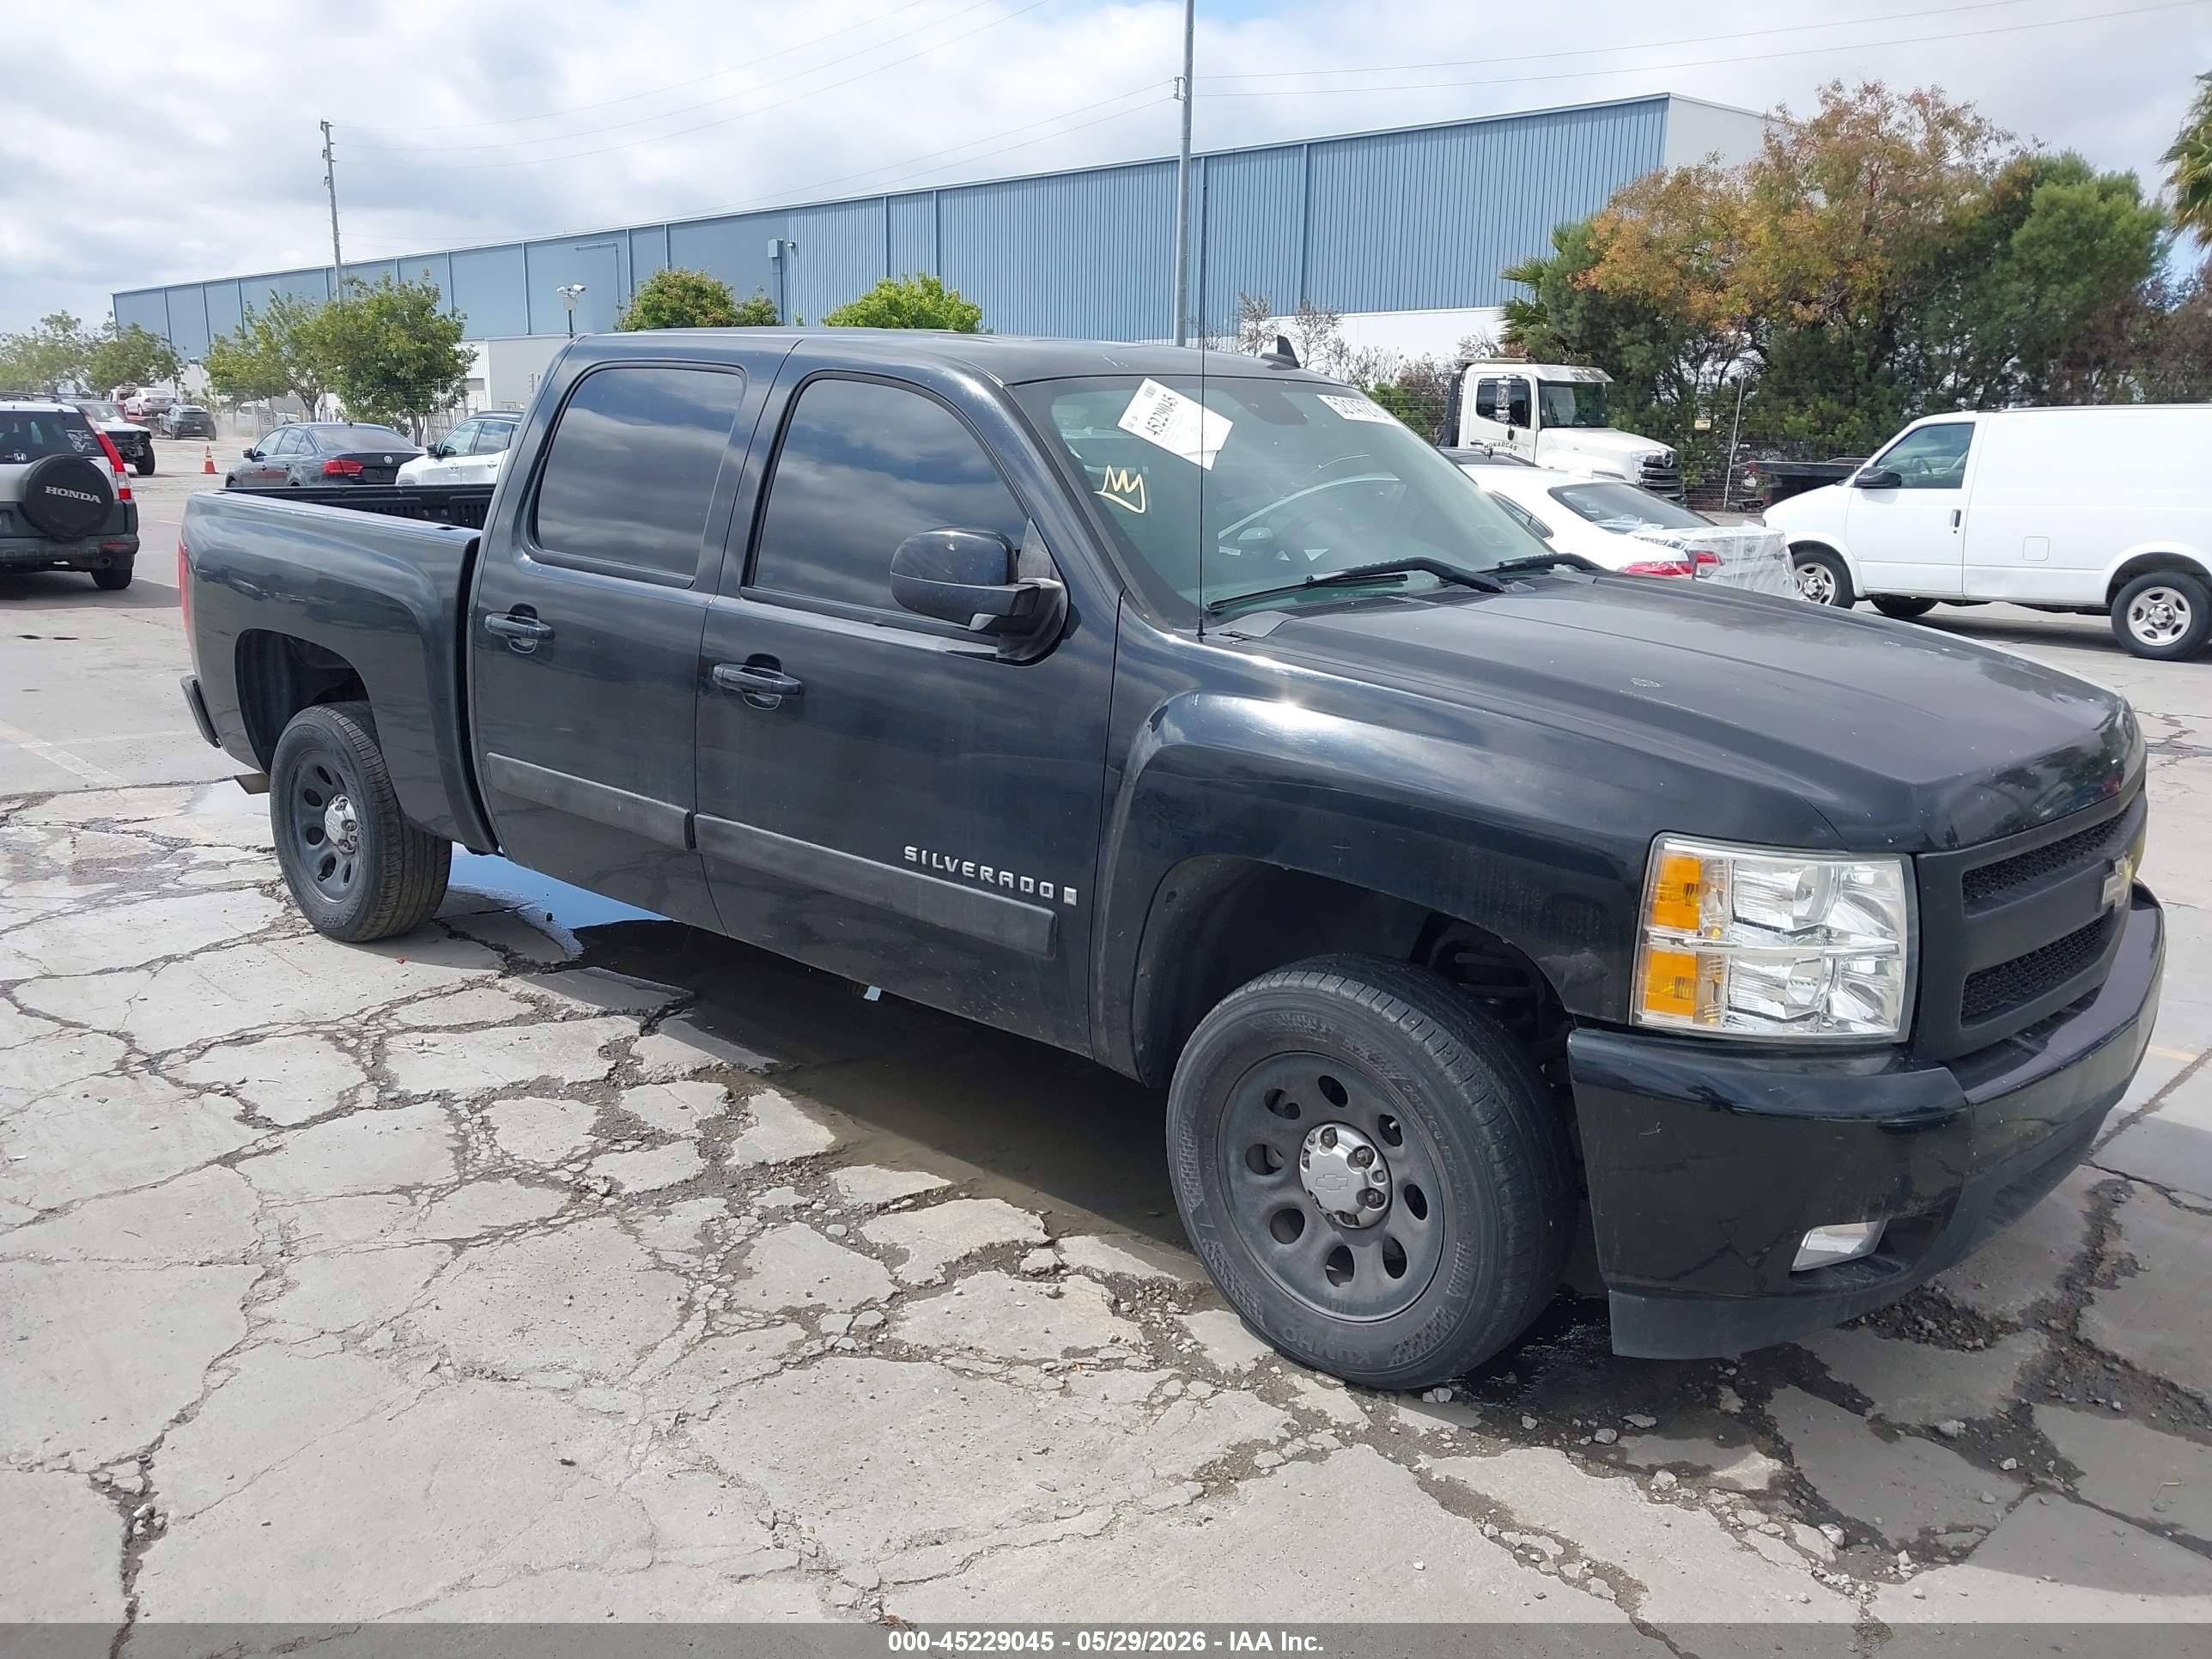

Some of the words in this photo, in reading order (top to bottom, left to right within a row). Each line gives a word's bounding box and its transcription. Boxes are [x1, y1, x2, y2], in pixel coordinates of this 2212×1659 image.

[1145, 393, 1179, 436] 45229045
[1484, 441, 1518, 451] MONARCAS
[44, 485, 102, 504] HONDA
[904, 845, 1054, 900] SILVERADO
[1281, 1327, 1373, 1365] KUMHO
